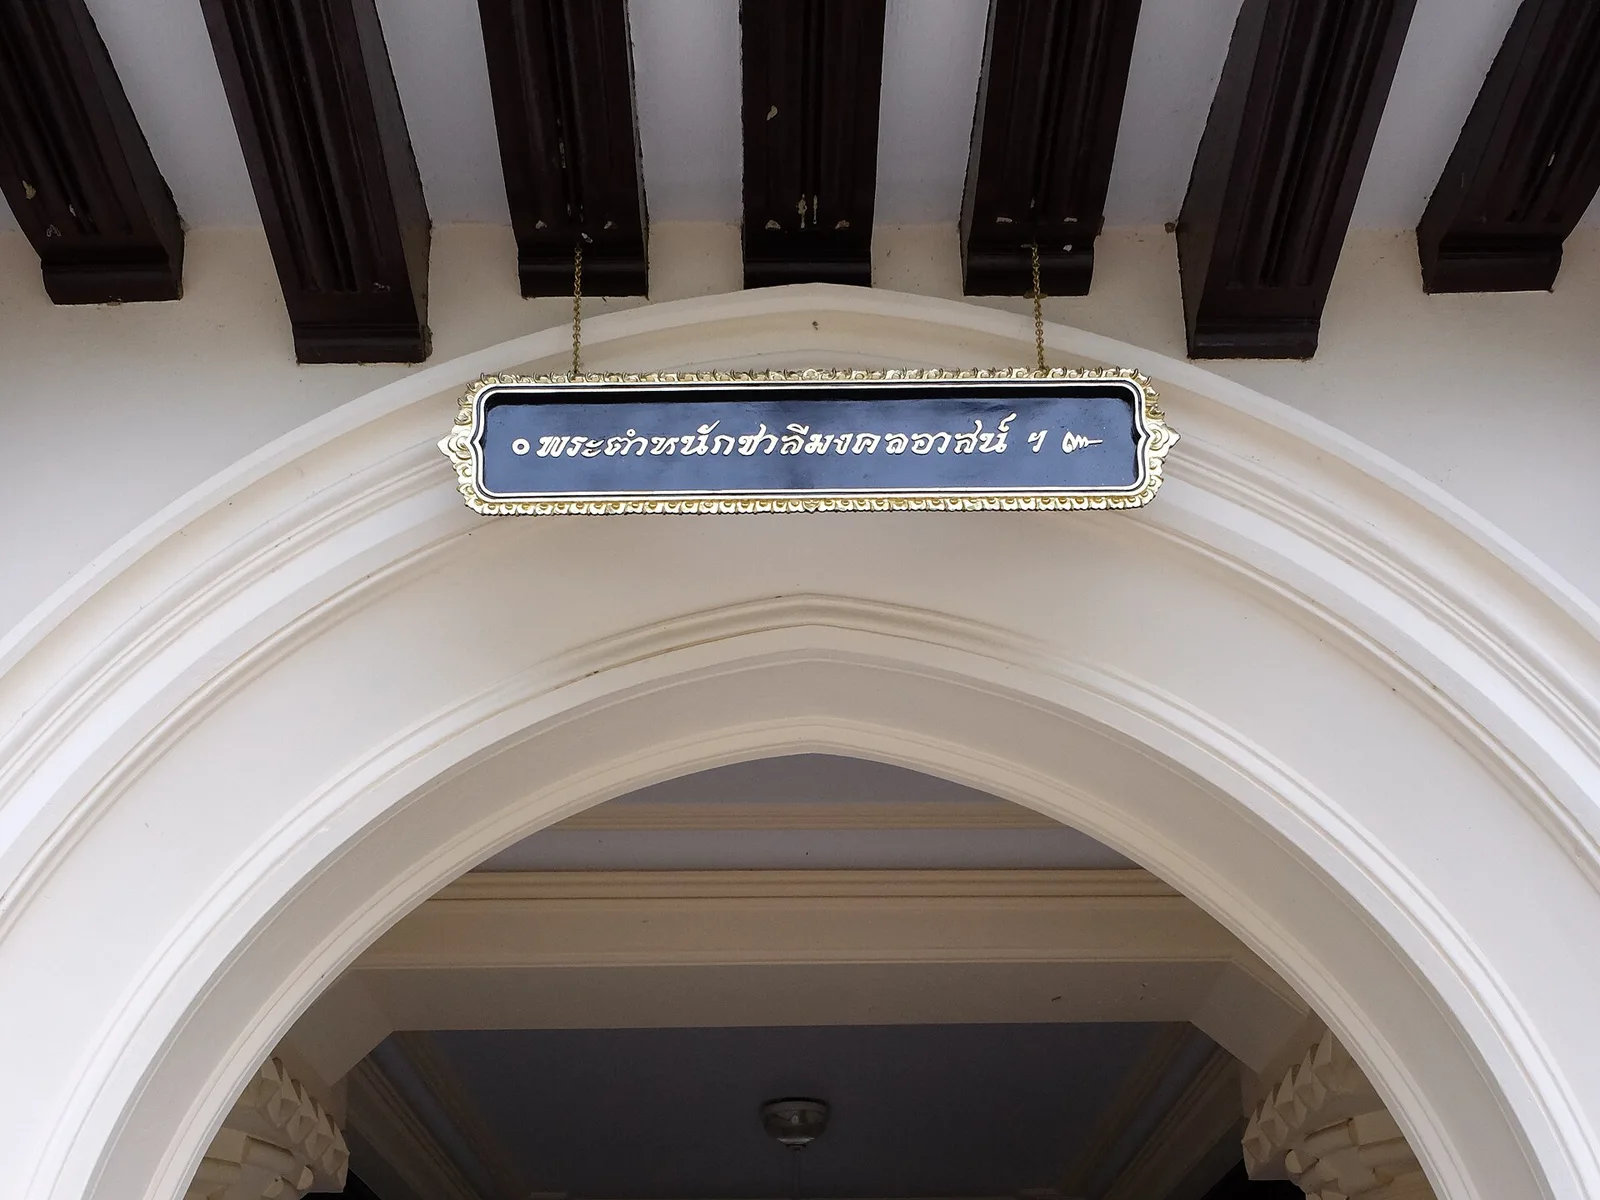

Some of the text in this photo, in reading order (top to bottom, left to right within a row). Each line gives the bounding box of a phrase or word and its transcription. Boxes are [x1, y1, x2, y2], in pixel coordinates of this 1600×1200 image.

[536, 412, 1017, 457] พระตำหนักชาลีมงคลอาสน์
